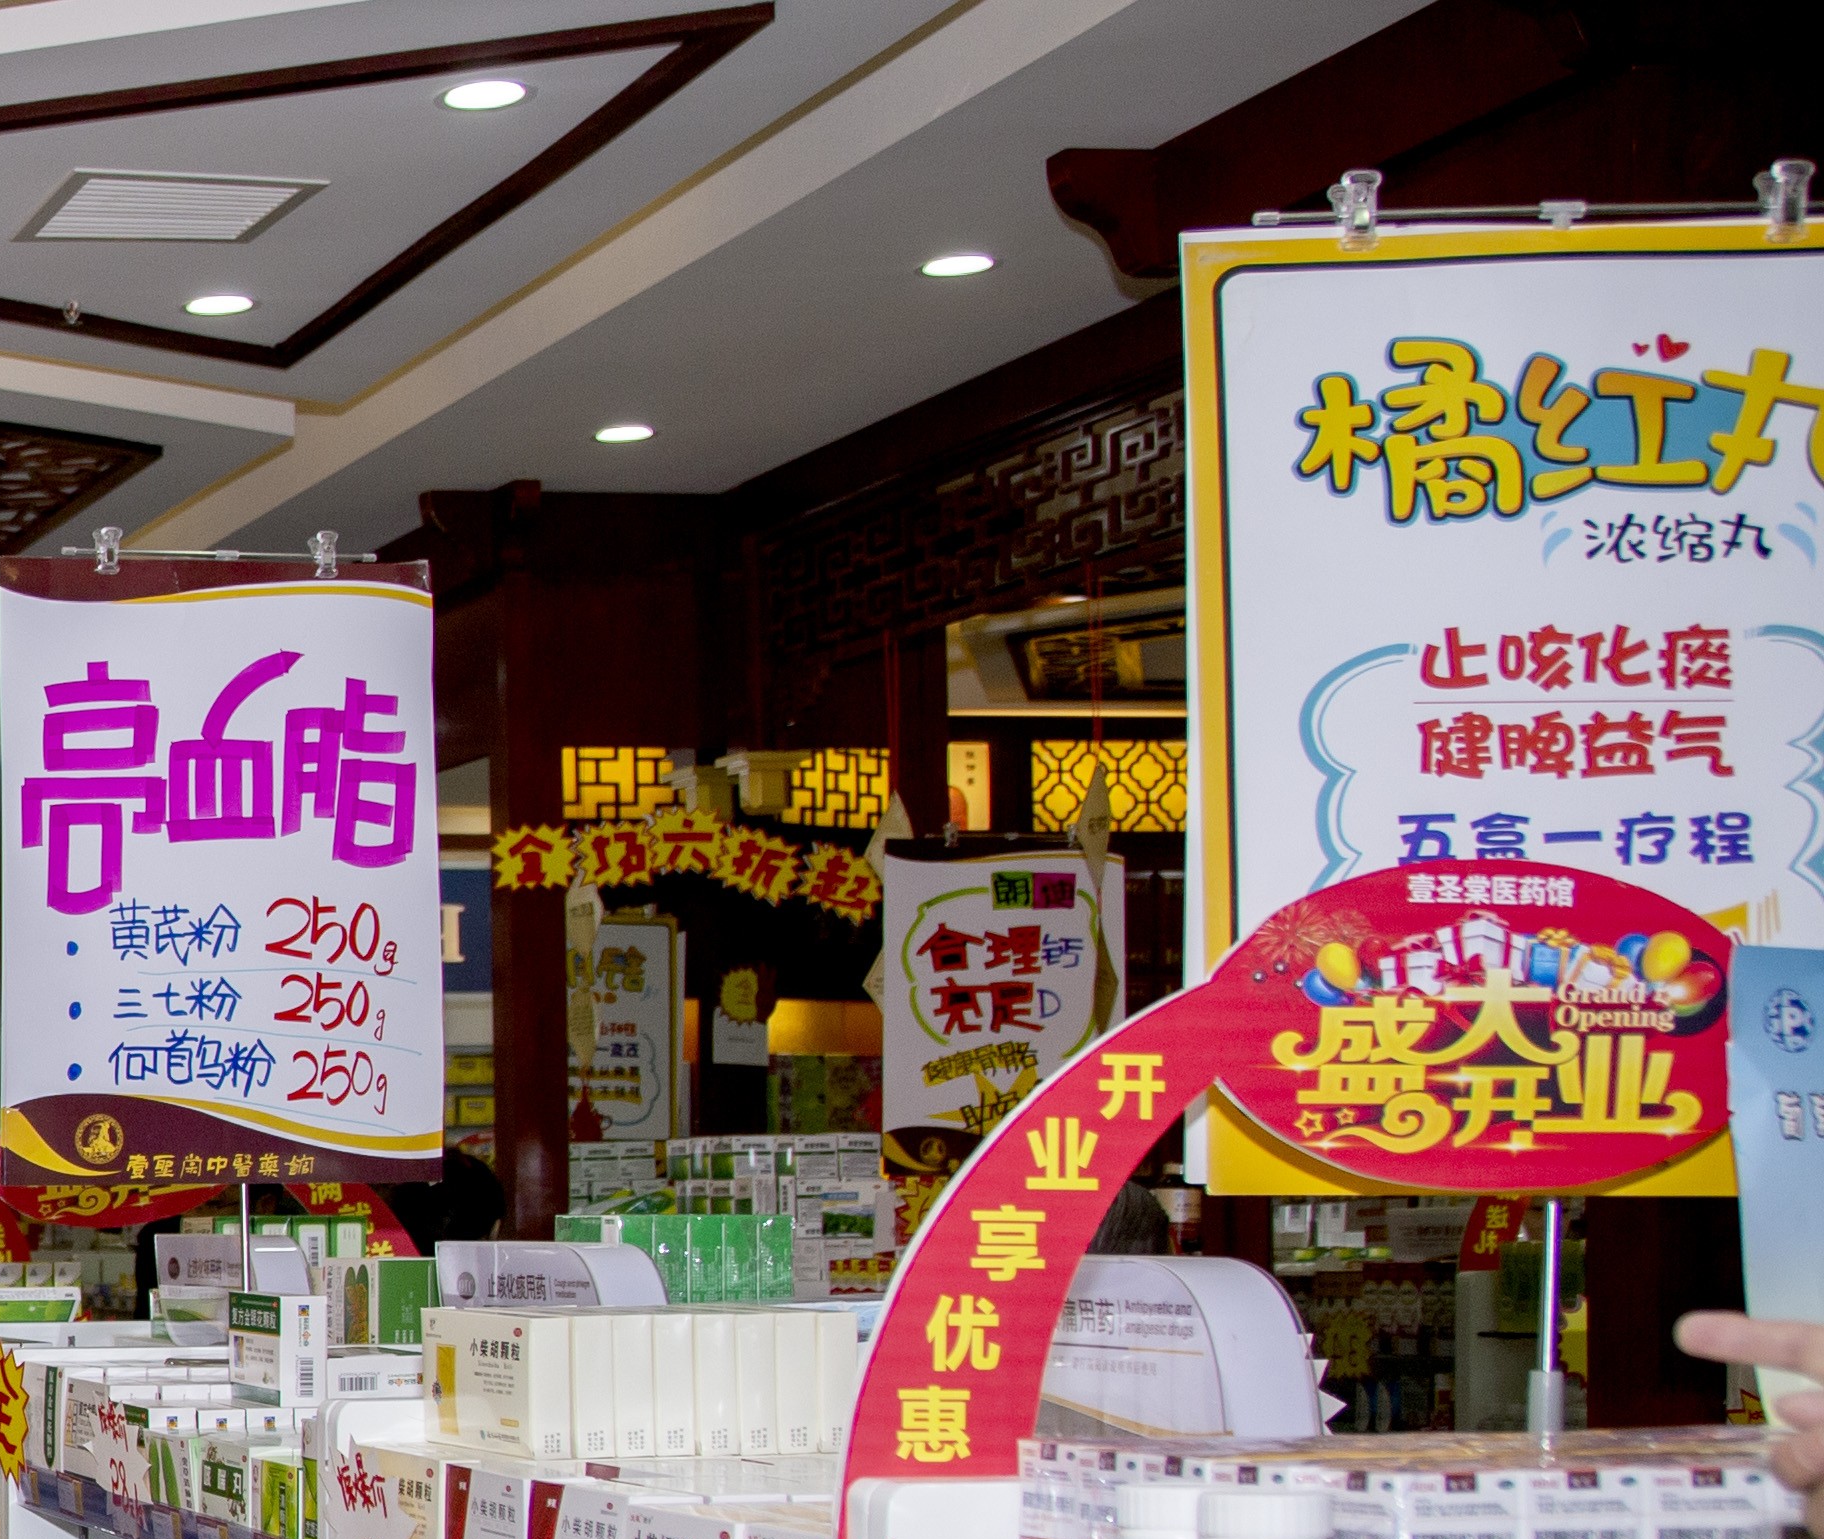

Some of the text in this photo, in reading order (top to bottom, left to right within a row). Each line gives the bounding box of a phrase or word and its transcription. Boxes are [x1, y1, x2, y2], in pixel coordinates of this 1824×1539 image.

[1295, 338, 1824, 525] 橘红丸
[1583, 514, 1773, 562] 浓缩丸
[1419, 624, 1733, 691] 止咳化痰
[1417, 711, 1735, 779] 健脾益气
[662, 818, 714, 869] 六
[731, 838, 790, 890] 折
[1398, 812, 1755, 866] 五盒一疗程
[1407, 873, 1575, 908] 壹圣棠医药馆
[113, 973, 388, 1041] 三七粉 250g
[1555, 1004, 1676, 1033] Opening
[1556, 982, 1646, 1006] Grand
[286, 1048, 389, 1115] 250g
[1271, 968, 1703, 1154] 盛大开业
[895, 1052, 1167, 1464] 开业享优惠
[486, 1272, 547, 1300] 止咳化痰用药
[469, 1337, 521, 1362] 小柴胡颗粒
[1168, 1320, 1195, 1338] drugs
[470, 1493, 517, 1526] 小柴胡颗粒
